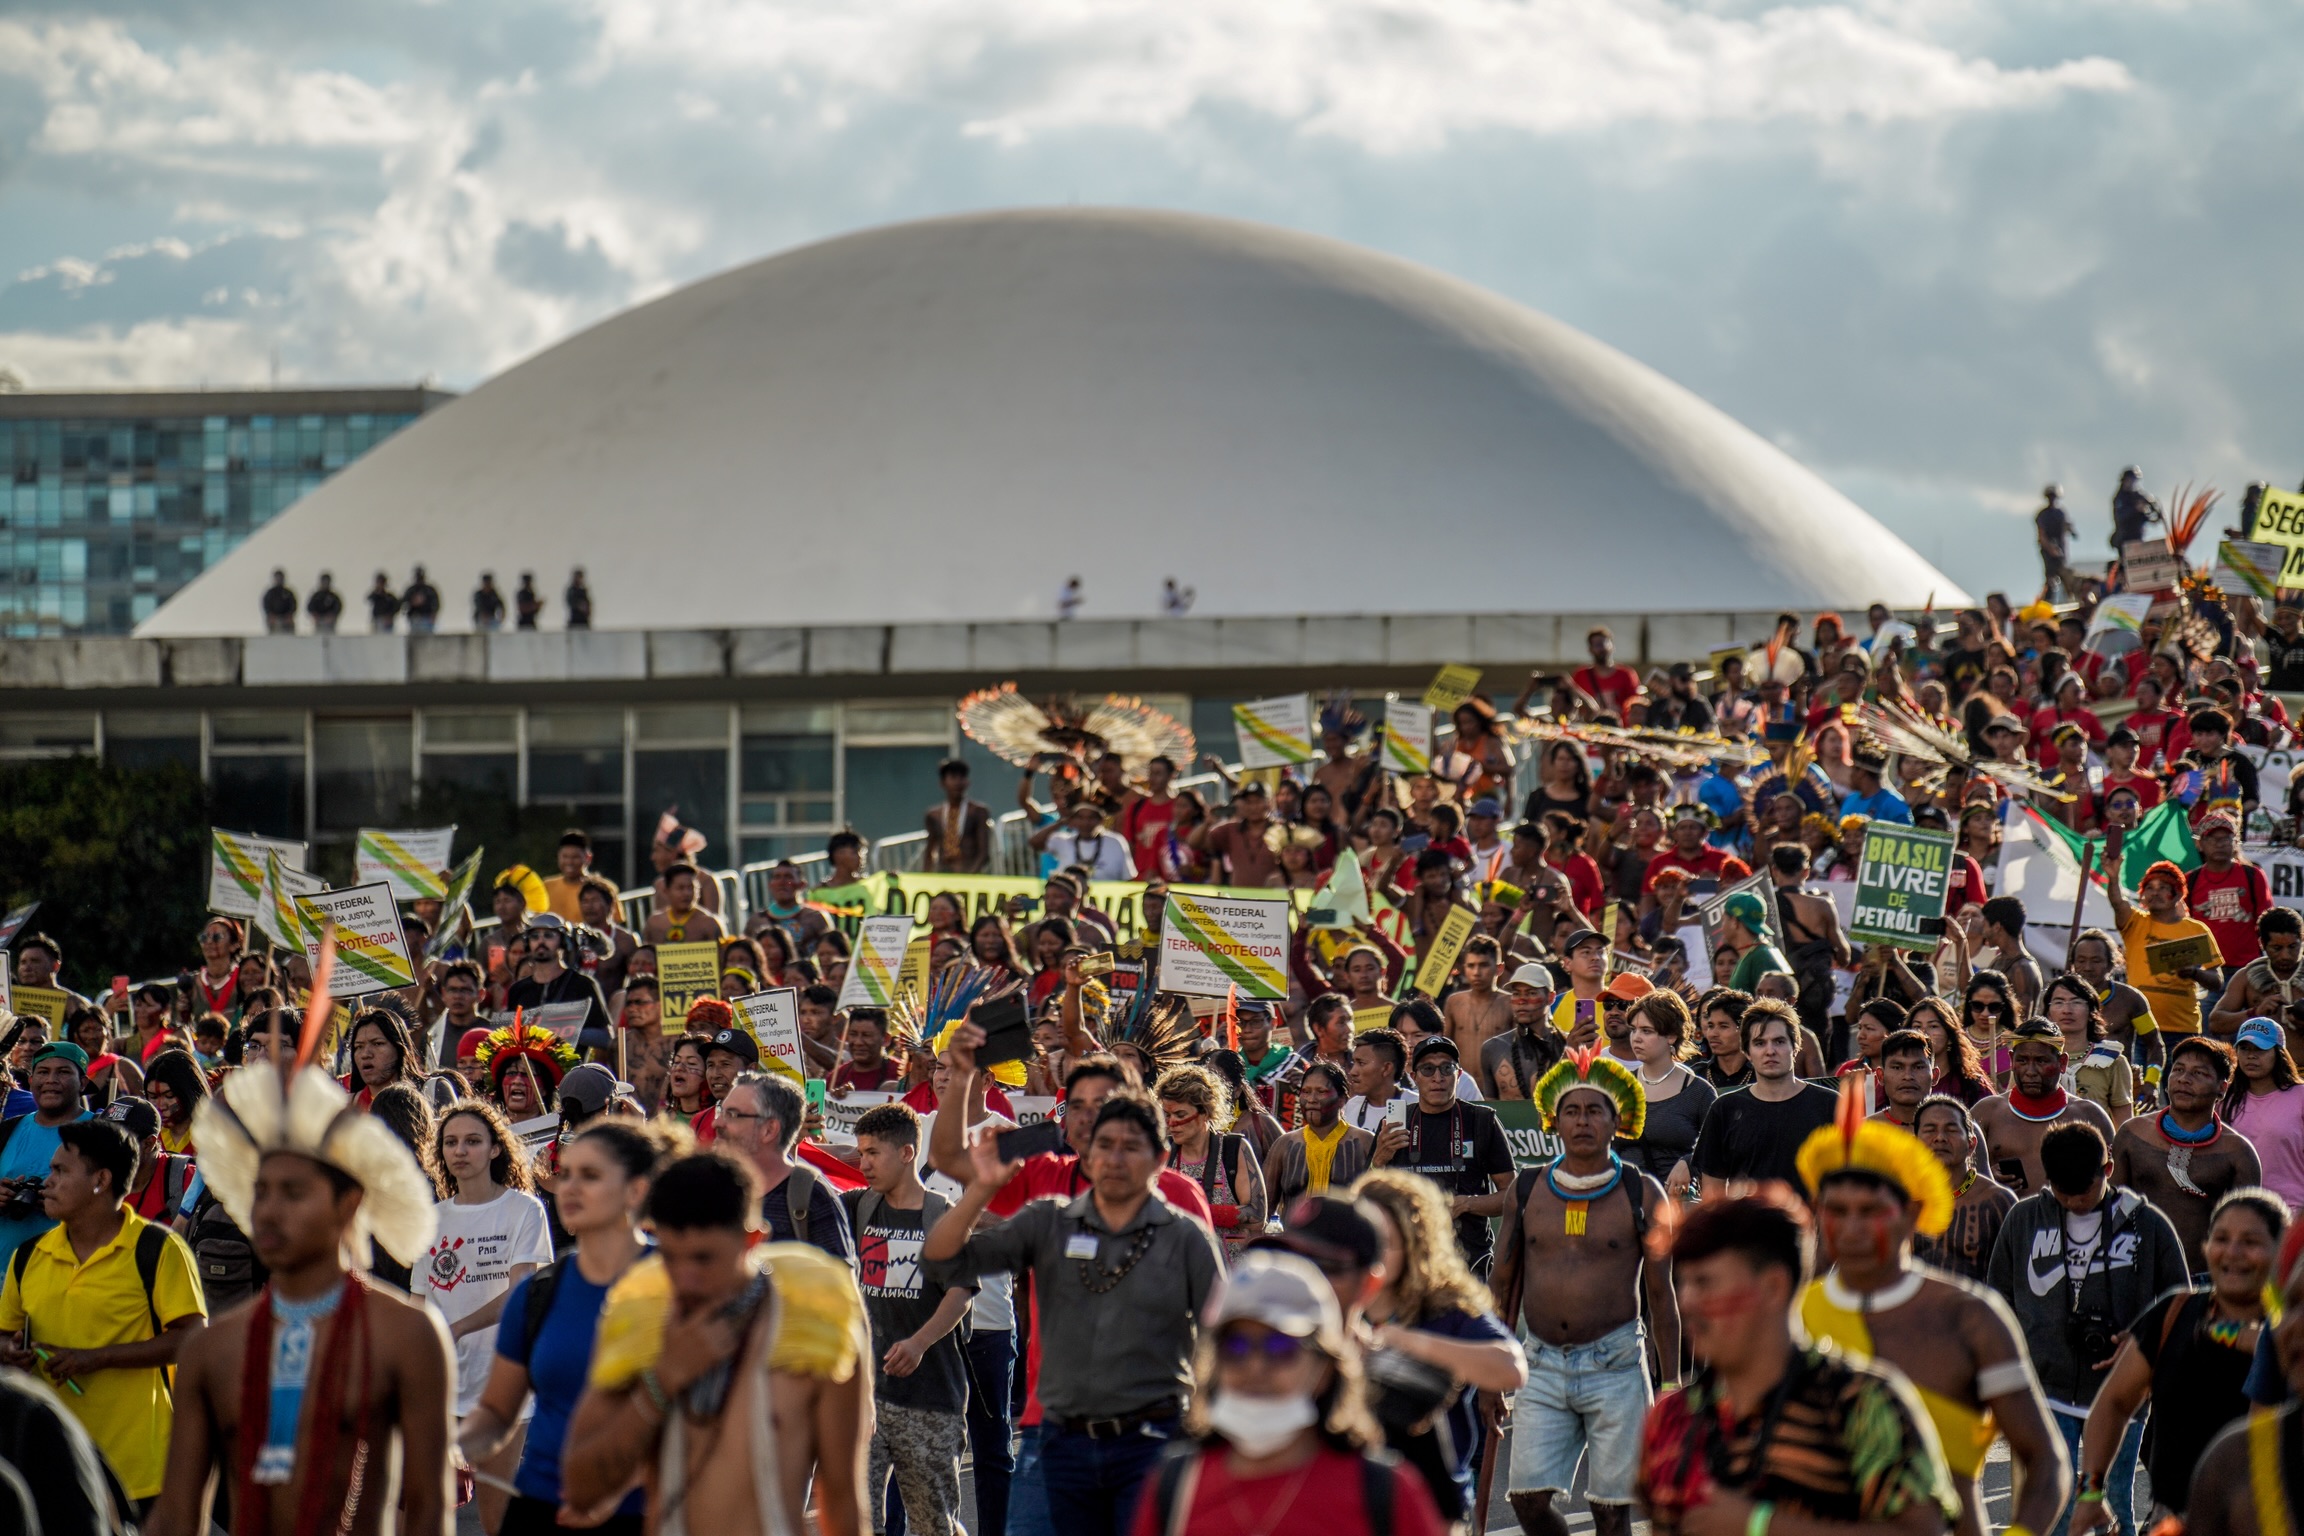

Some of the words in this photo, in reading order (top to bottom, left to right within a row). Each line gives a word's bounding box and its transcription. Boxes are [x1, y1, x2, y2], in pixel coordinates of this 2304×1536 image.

[1866, 836, 1945, 872] BRASIL
[1861, 861, 1944, 898] LIVRE
[304, 903, 333, 915] GOVERNO
[334, 896, 375, 911] FEDERAL
[1887, 892, 1910, 909] DE
[335, 915, 347, 923] DA
[347, 909, 376, 921] JUSTIÇA
[1181, 903, 1220, 915] GOVERNO
[1223, 907, 1267, 918] FEDERAL
[347, 922, 366, 932] Povos
[366, 918, 393, 929] Indígenas
[1181, 916, 1218, 927] MINISTÉRIO
[1232, 921, 1265, 930] JUSTIÇA
[1854, 906, 1926, 934] PETRÓL
[1230, 931, 1249, 939] Povos
[1250, 932, 1282, 940] Indígenas
[306, 943, 321, 956] TER
[335, 931, 398, 953] PROTEGIDA
[1166, 938, 1205, 953] TERRA
[1207, 943, 1282, 958] PROTEGIDA
[663, 962, 700, 971] TRILHOS
[701, 961, 713, 969] DA
[663, 970, 714, 980] DESTRUIÇÃO
[1111, 971, 1149, 990] FOR
[664, 991, 717, 1017] NÃ
[758, 1018, 778, 1027] JUSTIÇA
[2240, 1023, 2270, 1036] CARACAS
[769, 1028, 792, 1038] Indígenas
[759, 1043, 796, 1059] TEGIDA
[1504, 1128, 1566, 1157] SSOCI
[477, 1234, 508, 1244] MELHORES
[890, 1228, 926, 1241] JEANS
[880, 1288, 920, 1300] TOMMY
